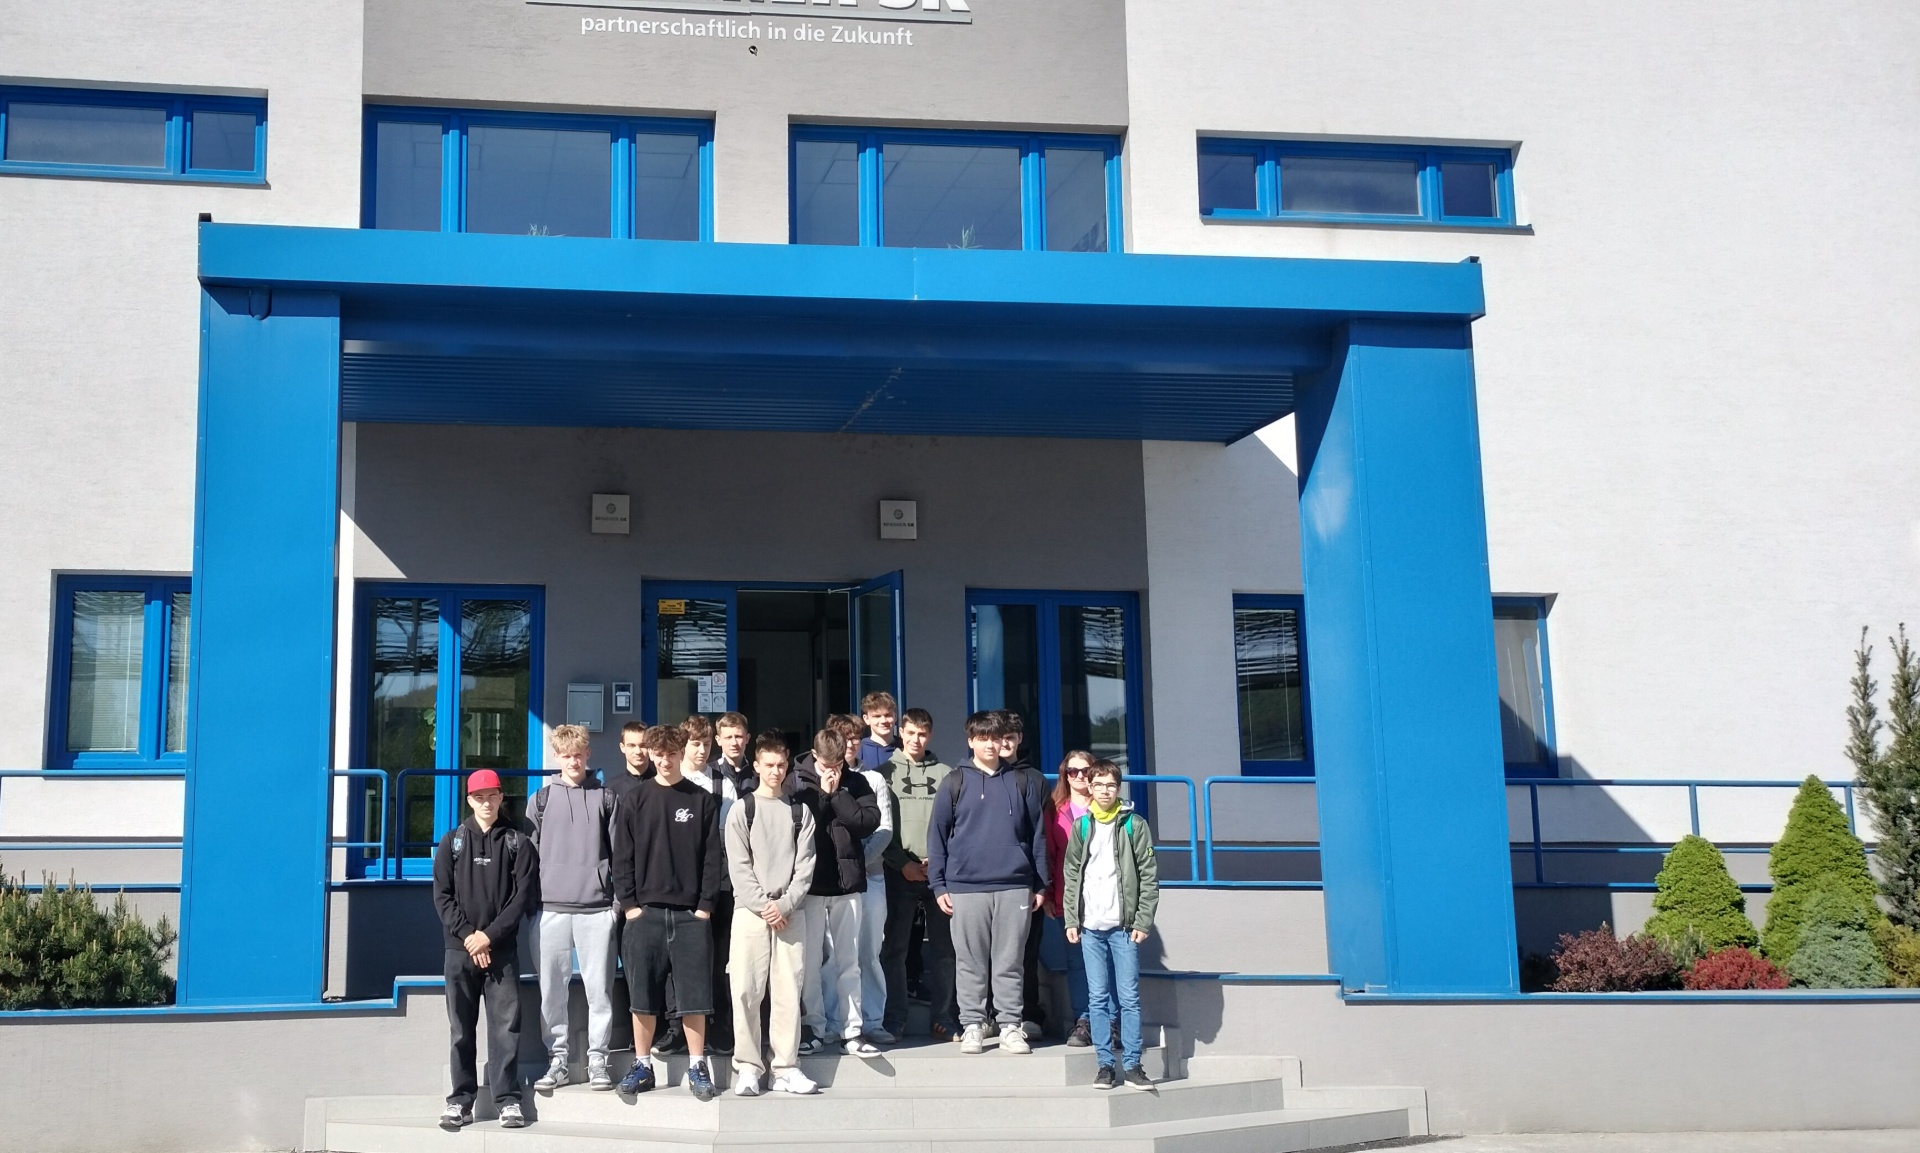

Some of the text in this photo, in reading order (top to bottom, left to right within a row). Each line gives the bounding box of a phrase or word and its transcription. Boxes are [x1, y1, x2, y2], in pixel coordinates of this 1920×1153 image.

[581, 17, 914, 46] partnerschaftlich in die Zukunft
